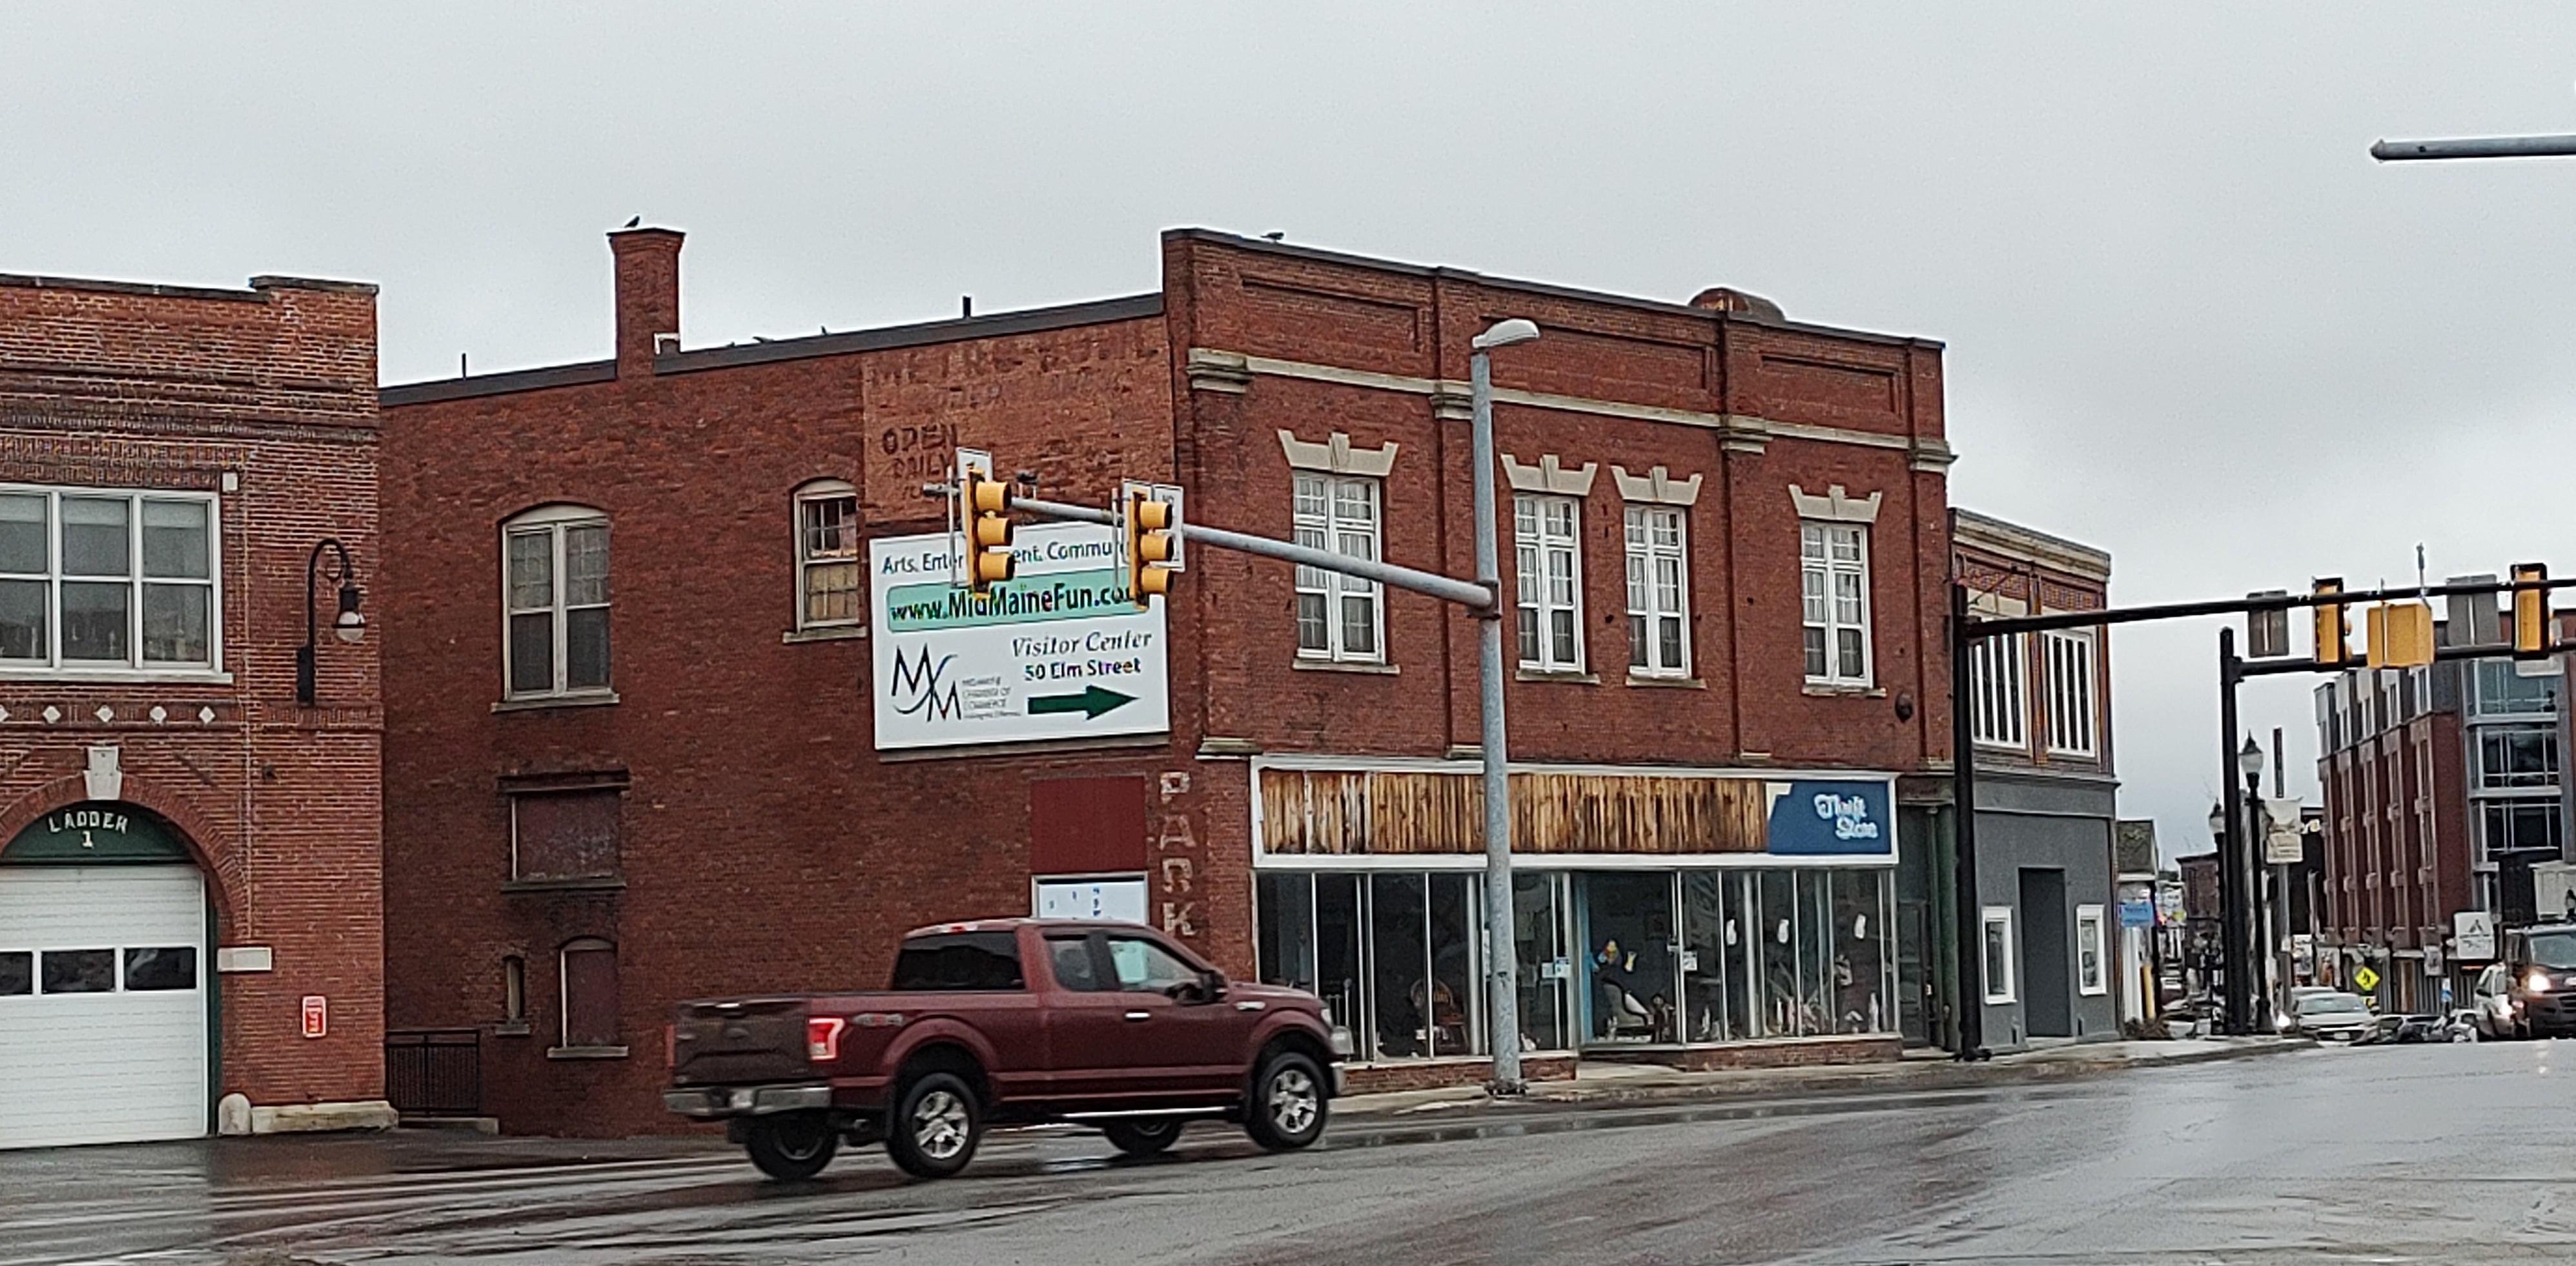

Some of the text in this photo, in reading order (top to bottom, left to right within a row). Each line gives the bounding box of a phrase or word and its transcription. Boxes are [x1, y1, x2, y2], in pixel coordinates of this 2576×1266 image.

[883, 423, 958, 454] OPEN
[1012, 629, 1152, 657] Visitor Center
[1024, 657, 1141, 682] 50 Elm Street
[48, 810, 128, 834] LADDER
[82, 830, 94, 848] 1
